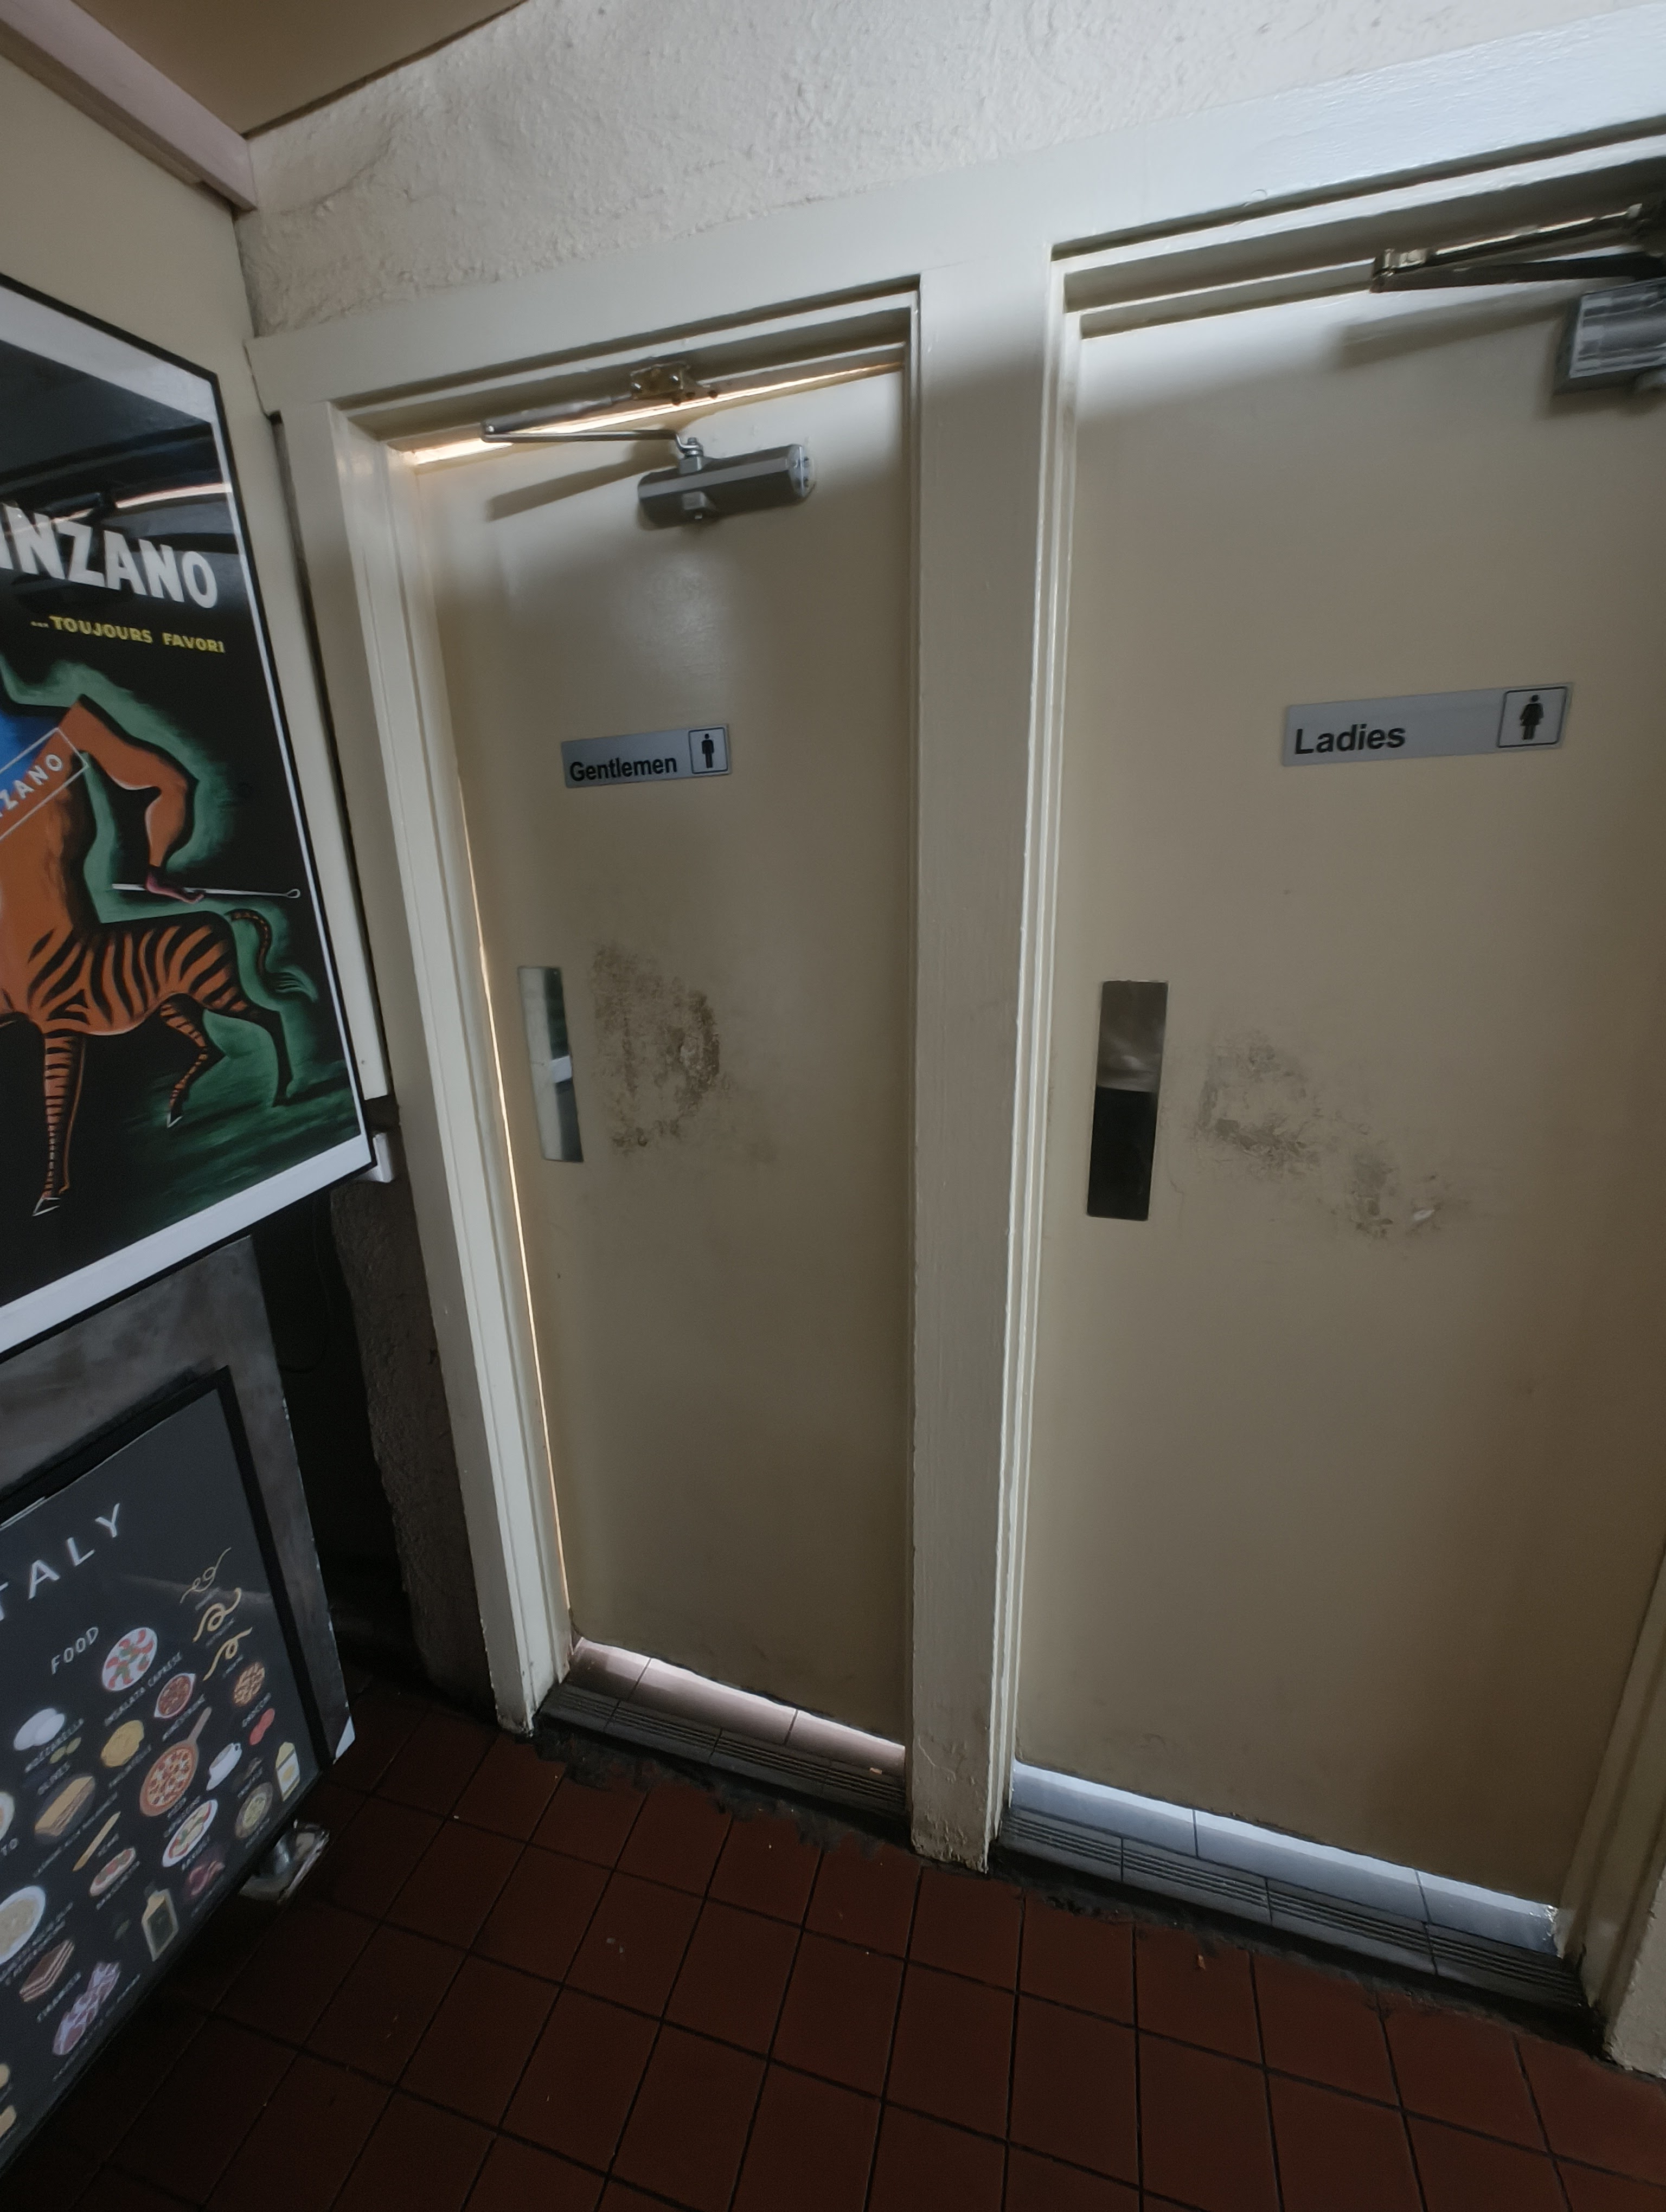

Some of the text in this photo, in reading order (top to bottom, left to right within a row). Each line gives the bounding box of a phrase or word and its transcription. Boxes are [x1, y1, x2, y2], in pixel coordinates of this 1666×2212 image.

[163, 632, 226, 654] FAVORI
[1295, 723, 1406, 755] Ladies
[569, 757, 677, 782] Gentlemen
[0, 754, 63, 818] ZANO
[52, 1626, 99, 1675] FOOD
